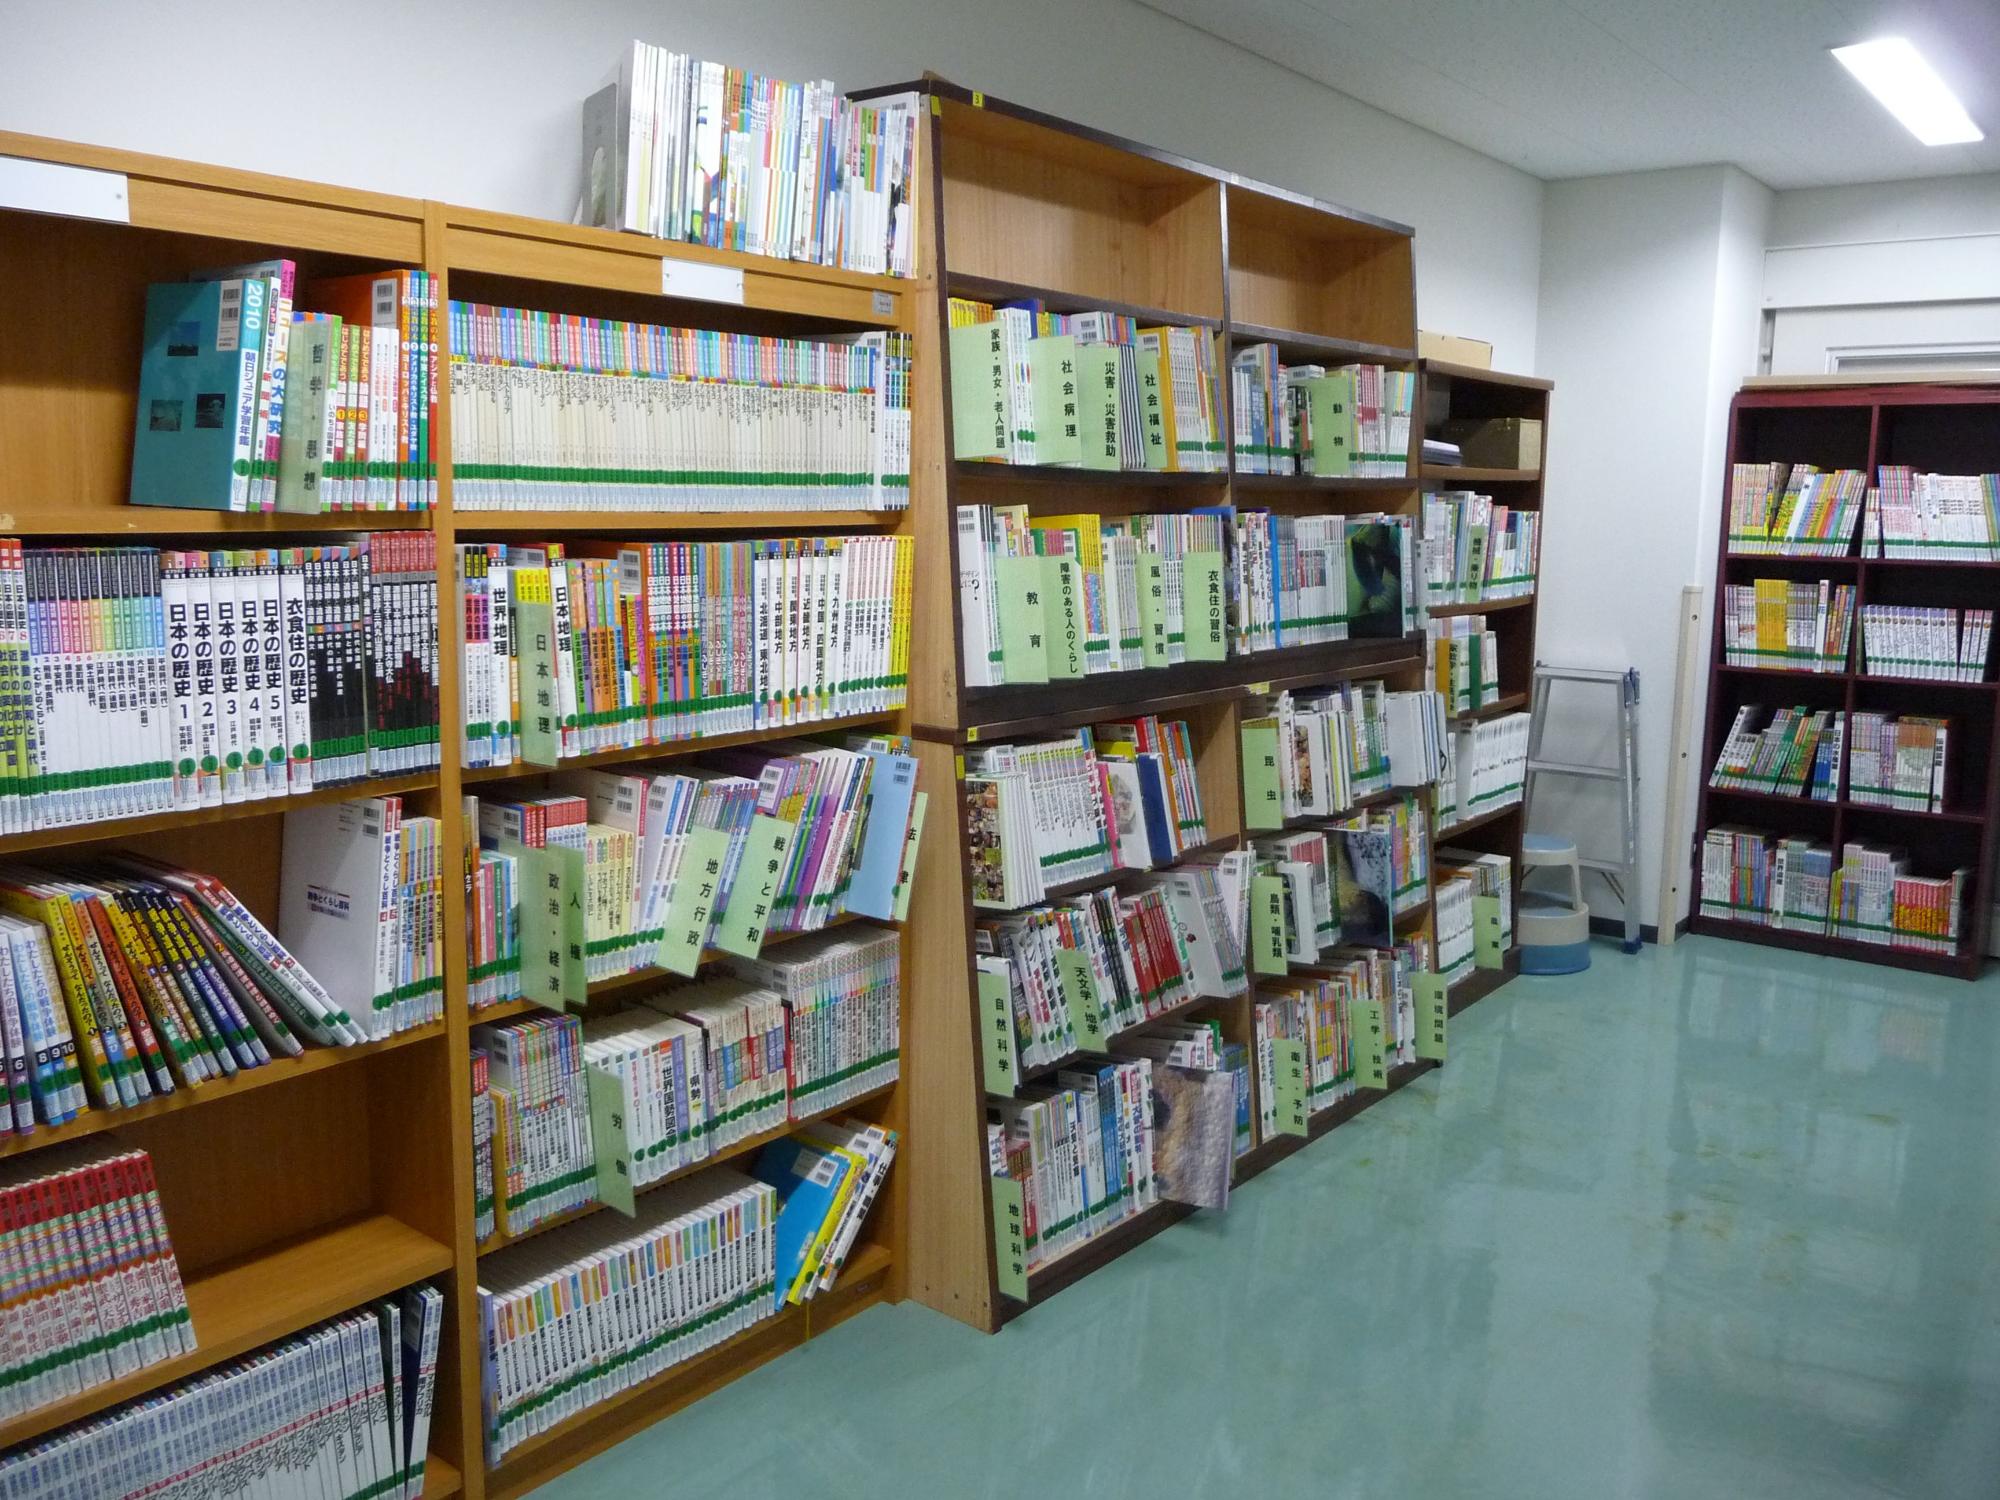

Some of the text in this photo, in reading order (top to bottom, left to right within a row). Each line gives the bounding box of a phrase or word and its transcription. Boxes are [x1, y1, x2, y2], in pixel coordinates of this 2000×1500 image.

[244, 283, 263, 330] 2010
[268, 301, 291, 433] ニュースの大研究
[991, 328, 1005, 449] 家族・男女・老人問題
[1061, 360, 1077, 437] 社会病理
[1105, 361, 1116, 457] 災害・災害救助
[1145, 374, 1162, 446] 社会福祉
[1333, 402, 1344, 447] 動物
[16, 584, 26, 629] 日本の歴史
[20, 631, 27, 640] 8
[492, 587, 509, 656] 世界地理
[556, 586, 571, 652] 日本地理
[774, 602, 783, 654] 中部地方
[789, 599, 798, 653] 関東地方
[802, 598, 811, 651] 近畿地方
[830, 597, 840, 648] 九州地方
[1026, 591, 1041, 648] 教育
[1060, 562, 1078, 673] 障害のある人のくらし
[1150, 565, 1165, 655] 風俗・習慣
[1208, 570, 1221, 643] 衣食住の習俗
[169, 603, 191, 719] 日本の歴史 1
[193, 602, 215, 717] 日本の歴史 2
[218, 601, 239, 746] 日本の歴史 3 江戸時代
[241, 600, 262, 712] 日本の歴史 4
[262, 599, 282, 710] 日本の歴史 5
[286, 597, 308, 704] 衣食住の歴史
[815, 598, 825, 686] 中国・四国地方
[53, 665, 63, 694] 平安時代
[536, 634, 551, 734] 日本地理
[1264, 756, 1277, 801] 昆虫
[380, 835, 392, 909] 戦争とくらし百科
[746, 836, 787, 943] 戦争と平和
[900, 827, 916, 884] 法律
[548, 873, 560, 993] 政治・経済
[570, 891, 581, 961] 人権
[687, 858, 719, 947] 地方行政
[25, 939, 61, 1058] わたしたちの戦争体験 9
[1074, 966, 1099, 1035] 天文学・地学
[14, 1058, 24, 1069] 6
[37, 1052, 47, 1063] 8
[62, 1043, 75, 1053] 10
[995, 998, 1009, 1072] 自然科学
[1369, 1010, 1383, 1080] 工学・技術
[690, 1074, 701, 1101] 県勢
[1291, 1051, 1303, 1126] 衛生・予防
[612, 1112, 627, 1176] 労働
[1008, 1203, 1023, 1275] 地球科学
[33, 1299, 54, 1347] 織田信長
[77, 1284, 98, 1326] 卑弥呼
[122, 1272, 144, 1319] 豊臣秀吉
[134, 1267, 155, 1314] 徳川家康
